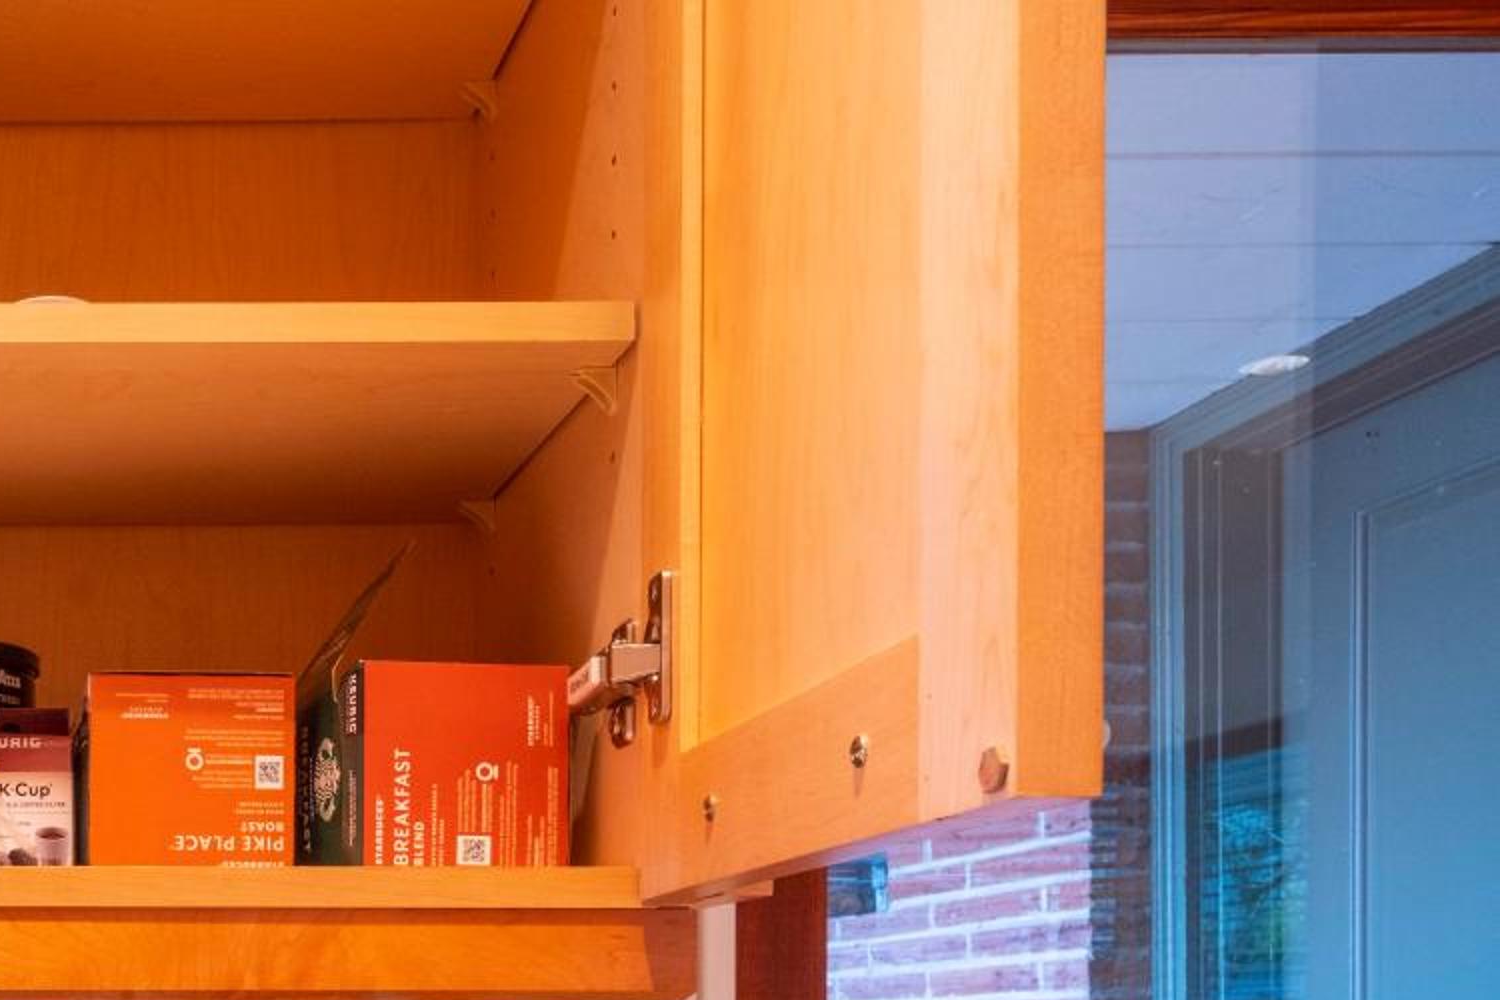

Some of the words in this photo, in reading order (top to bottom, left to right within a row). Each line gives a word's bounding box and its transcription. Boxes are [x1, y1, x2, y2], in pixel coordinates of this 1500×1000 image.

[393, 748, 411, 865] BREAKFAST
[241, 821, 285, 832] ROAST
[375, 799, 384, 865] STARBUCKS
[174, 835, 235, 851] PLACE
[242, 835, 285, 851] PIKE
[413, 821, 425, 866] BLEND
